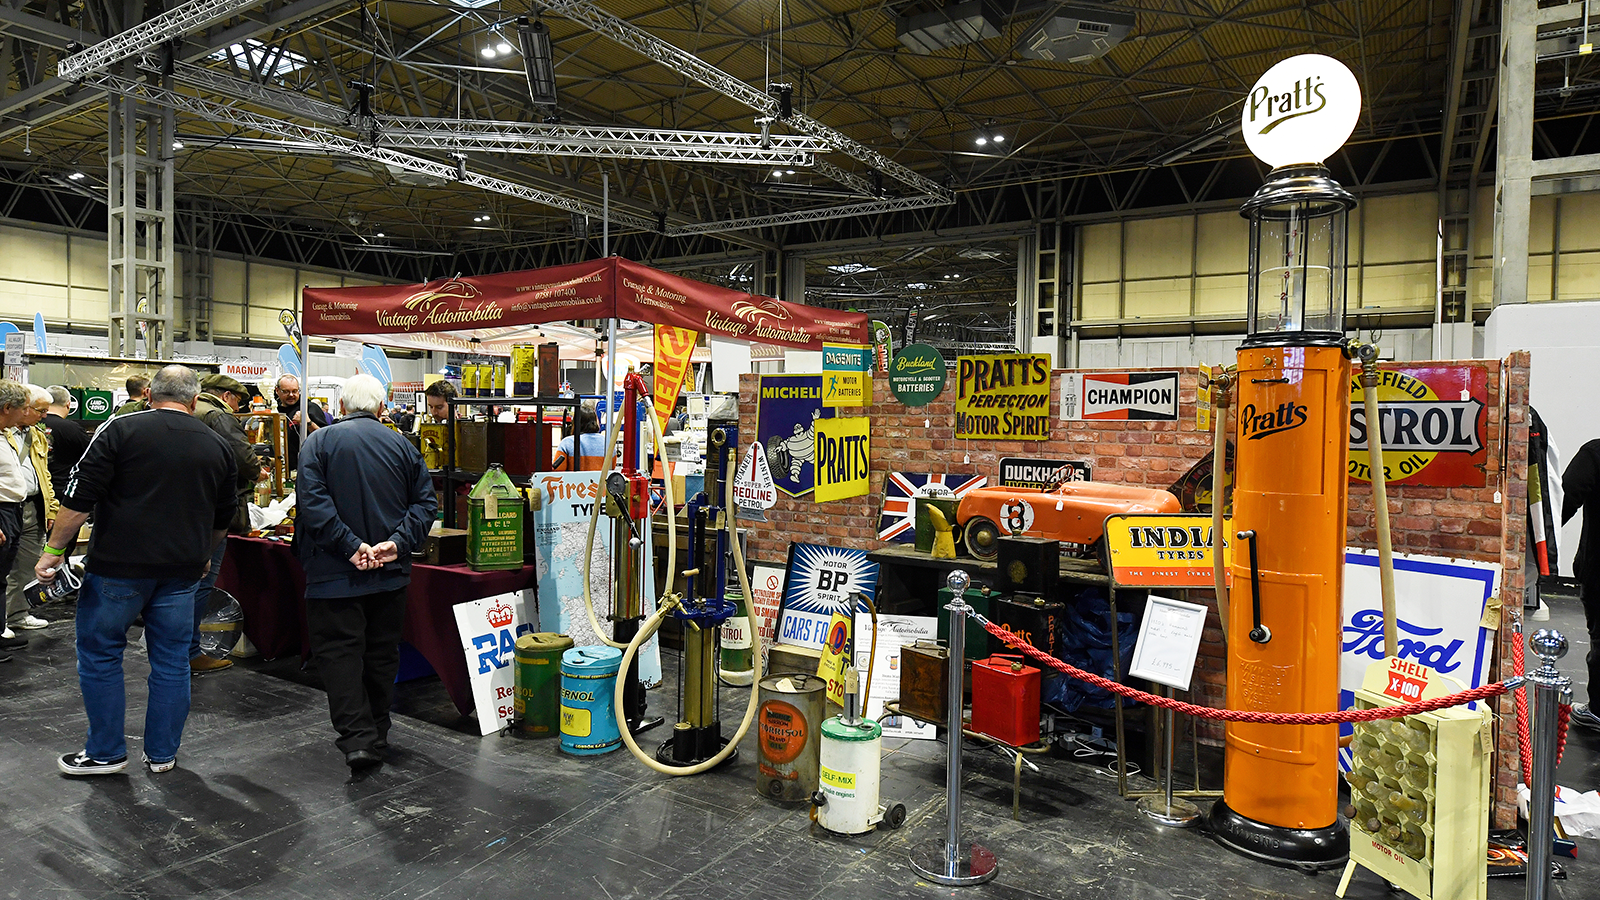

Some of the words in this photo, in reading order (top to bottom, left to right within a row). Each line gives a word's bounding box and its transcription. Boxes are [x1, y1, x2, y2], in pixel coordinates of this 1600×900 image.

[554, 287, 577, 297] 107400
[623, 277, 646, 293] Garage
[646, 285, 654, 295] &
[655, 287, 687, 304] Motoring
[334, 301, 358, 311] Motoring
[376, 309, 418, 331] Vintage
[422, 301, 503, 325] Automobilia
[705, 310, 747, 337] Vintage
[749, 318, 812, 344] Automobilia
[826, 352, 861, 366] DAGENITE
[896, 356, 936, 372] Buckland
[227, 365, 267, 375] MAGNUM
[958, 355, 1048, 401] PRATT'S
[842, 376, 857, 385] MOTOR
[897, 383, 935, 392] BATTERIES
[1351, 371, 1427, 400] AFIELD
[762, 387, 821, 399] MICHELI
[838, 388, 861, 397] BATTERIES
[1087, 388, 1172, 405] CHAMPION
[967, 394, 1049, 409] PERFECTION
[956, 411, 1000, 435] MOTOR
[1002, 411, 1049, 436] SPIRIT
[1349, 407, 1475, 446] STROL
[817, 431, 868, 487] PRATTS
[1349, 459, 1392, 479] OTR
[1399, 453, 1429, 475] OIL
[734, 453, 753, 485] SUMMER
[758, 456, 771, 488] WINTER
[540, 476, 606, 505] Fires
[733, 486, 772, 502] REDLINE
[571, 503, 606, 517] TYRE
[739, 498, 764, 509] PETROL
[1157, 550, 1205, 560] TYRES
[823, 560, 847, 569] MOTOR
[817, 593, 841, 602] SPIRIT
[764, 618, 772, 628] OR
[783, 615, 812, 642] CARS
[813, 620, 829, 645] FO
[721, 627, 744, 641] STROL
[1001, 623, 1033, 647] Ptts
[1343, 609, 1465, 674] Ford
[1390, 658, 1429, 680] SHELL
[495, 686, 515, 701] Re
[561, 687, 596, 702] ERNOL
[827, 679, 845, 698] STO
[1390, 677, 1420, 698] X-100
[498, 705, 515, 719] Se
[1371, 840, 1392, 857] MOTOR
[1394, 853, 1405, 865] OIL
